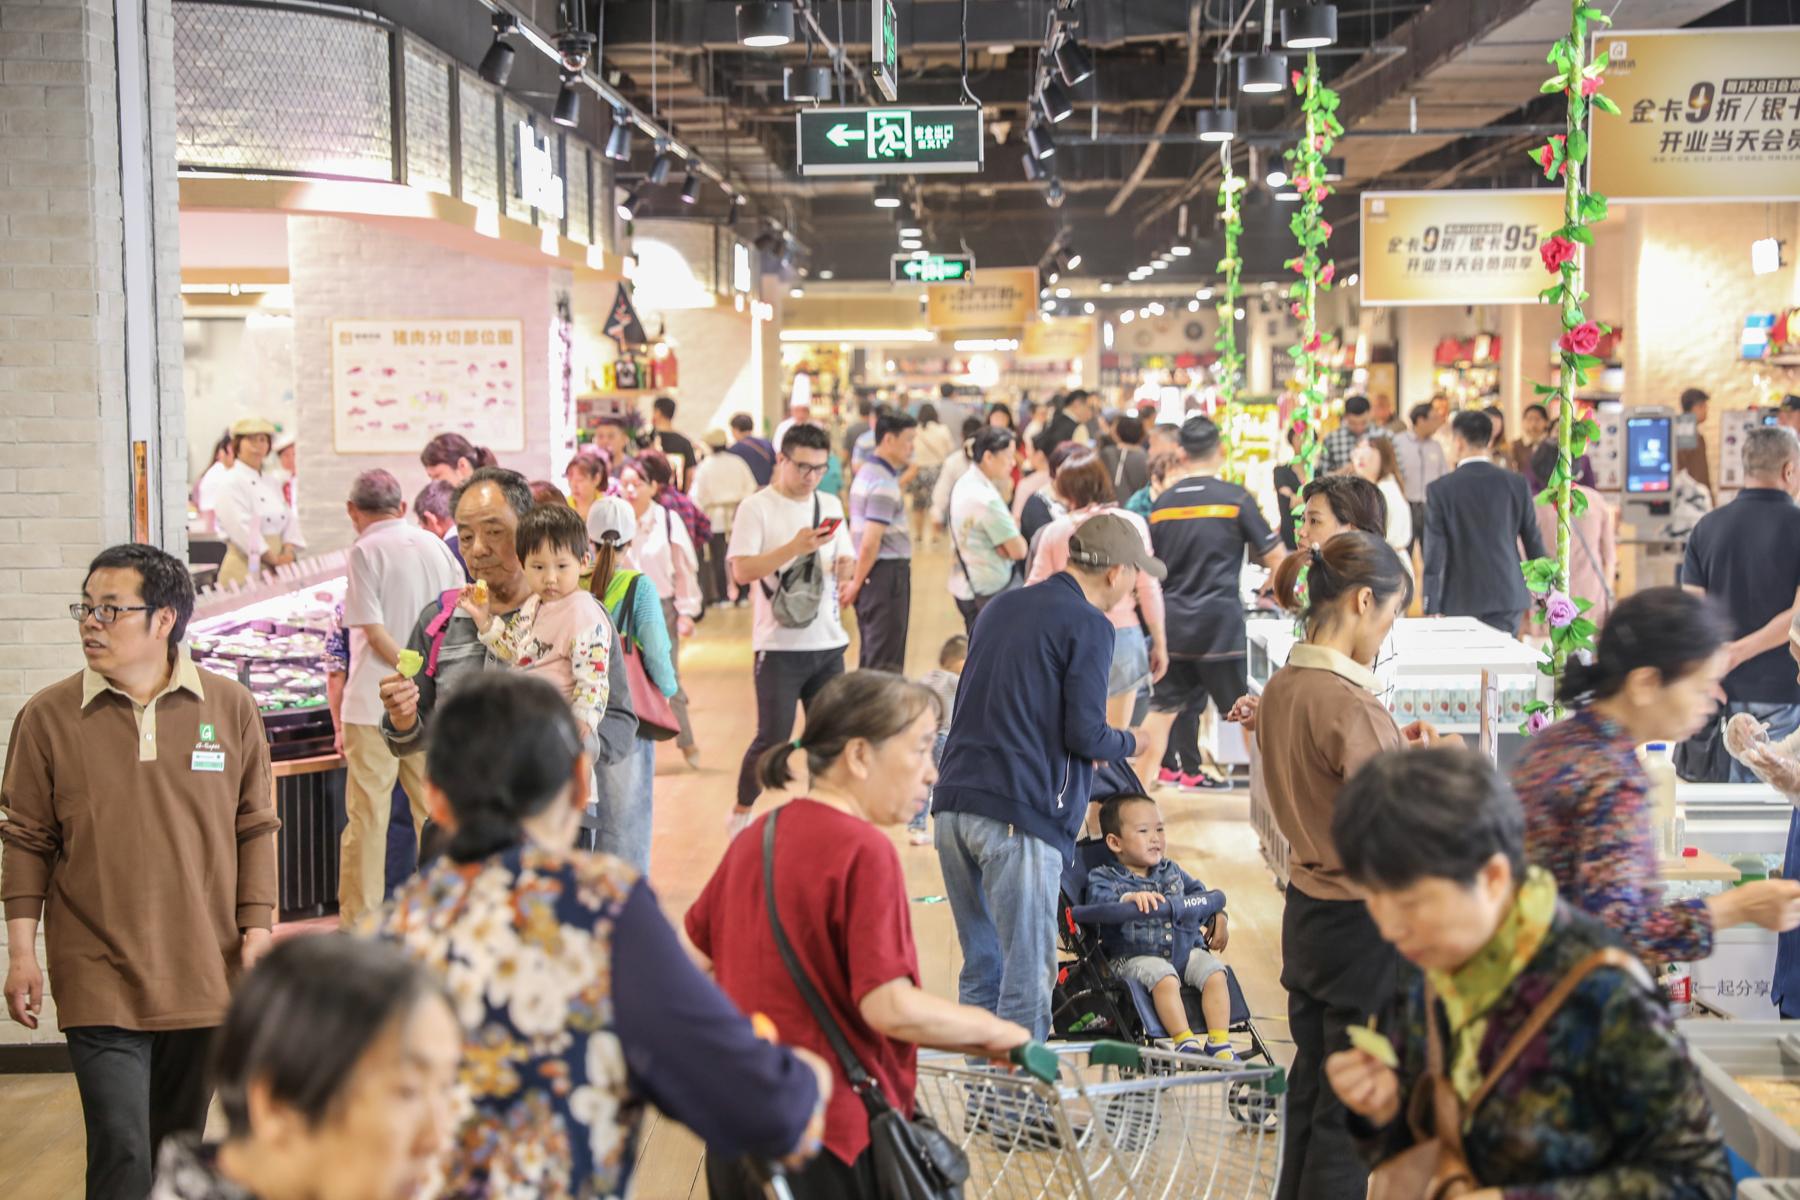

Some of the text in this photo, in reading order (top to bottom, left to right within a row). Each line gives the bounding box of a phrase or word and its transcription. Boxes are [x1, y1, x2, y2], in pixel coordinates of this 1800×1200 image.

[914, 124, 954, 141] 安全出口
[918, 139, 950, 150] EXIT
[1387, 224, 1547, 254] 金卡9折/银卡95
